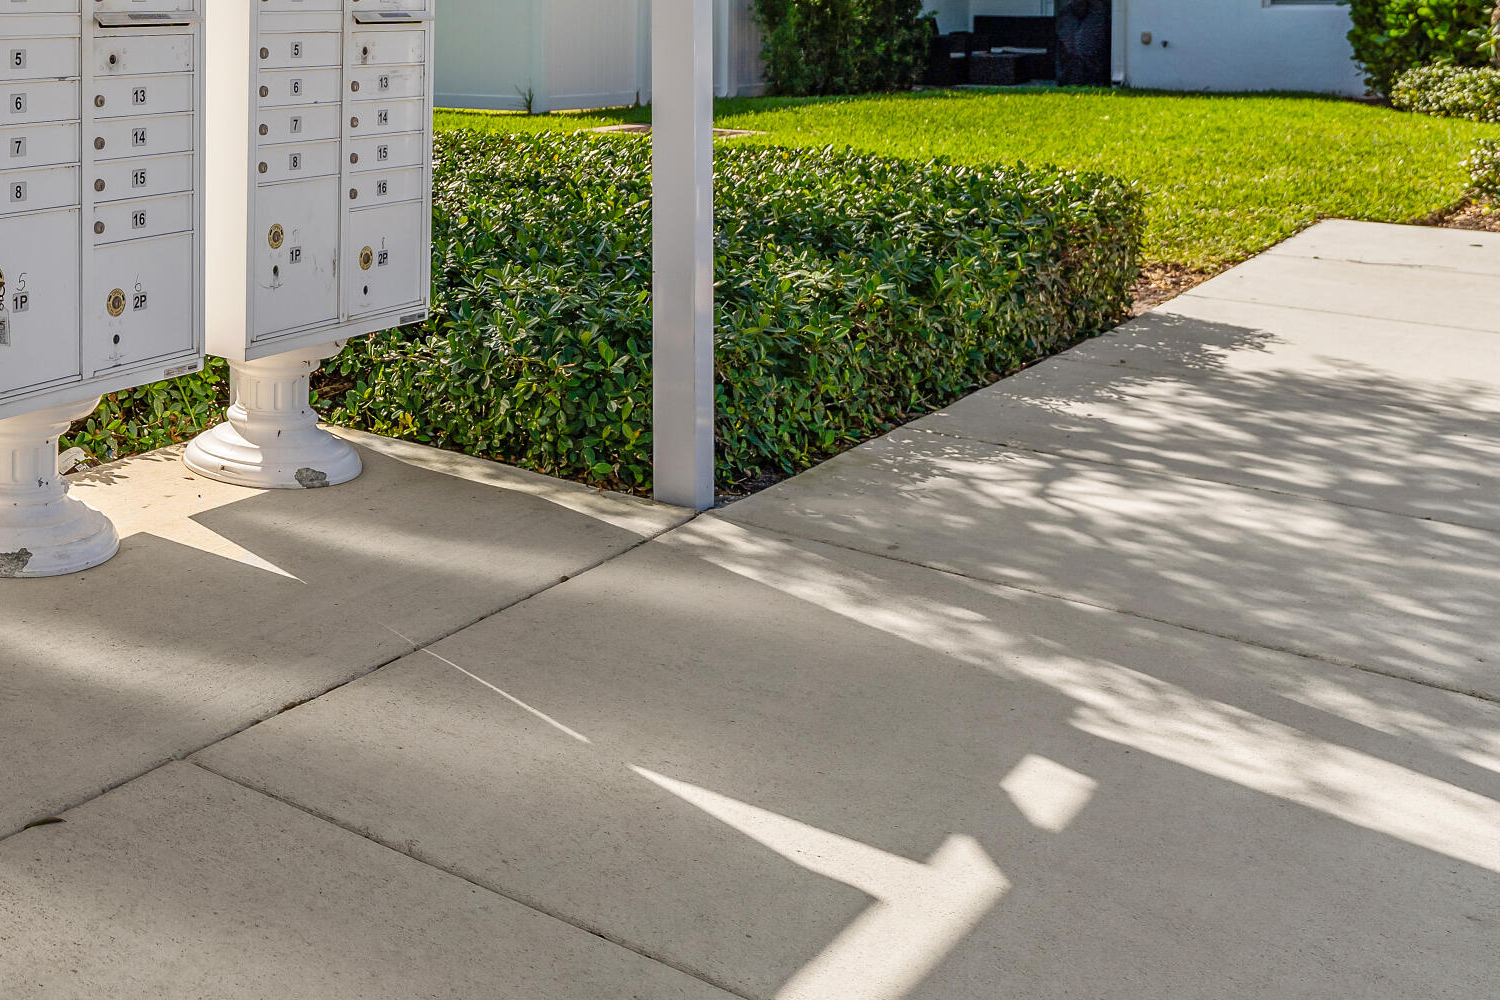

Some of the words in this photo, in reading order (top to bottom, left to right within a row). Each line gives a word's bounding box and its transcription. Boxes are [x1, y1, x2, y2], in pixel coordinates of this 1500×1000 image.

[15, 52, 22, 66] 5
[379, 76, 389, 89] 13
[133, 89, 146, 103] 13
[15, 96, 22, 111] 6
[378, 112, 388, 123] 14
[133, 130, 146, 144] 14
[14, 140, 22, 154] 7
[378, 147, 388, 159] 15
[133, 171, 146, 185] 15
[15, 185, 22, 199] 8
[377, 182, 387, 194] 16
[133, 212, 145, 227] 16
[289, 248, 301, 262] 1P
[378, 252, 388, 265] 2P
[16, 272, 28, 292] 5
[13, 294, 28, 310] 1P
[133, 294, 147, 309] 2P
